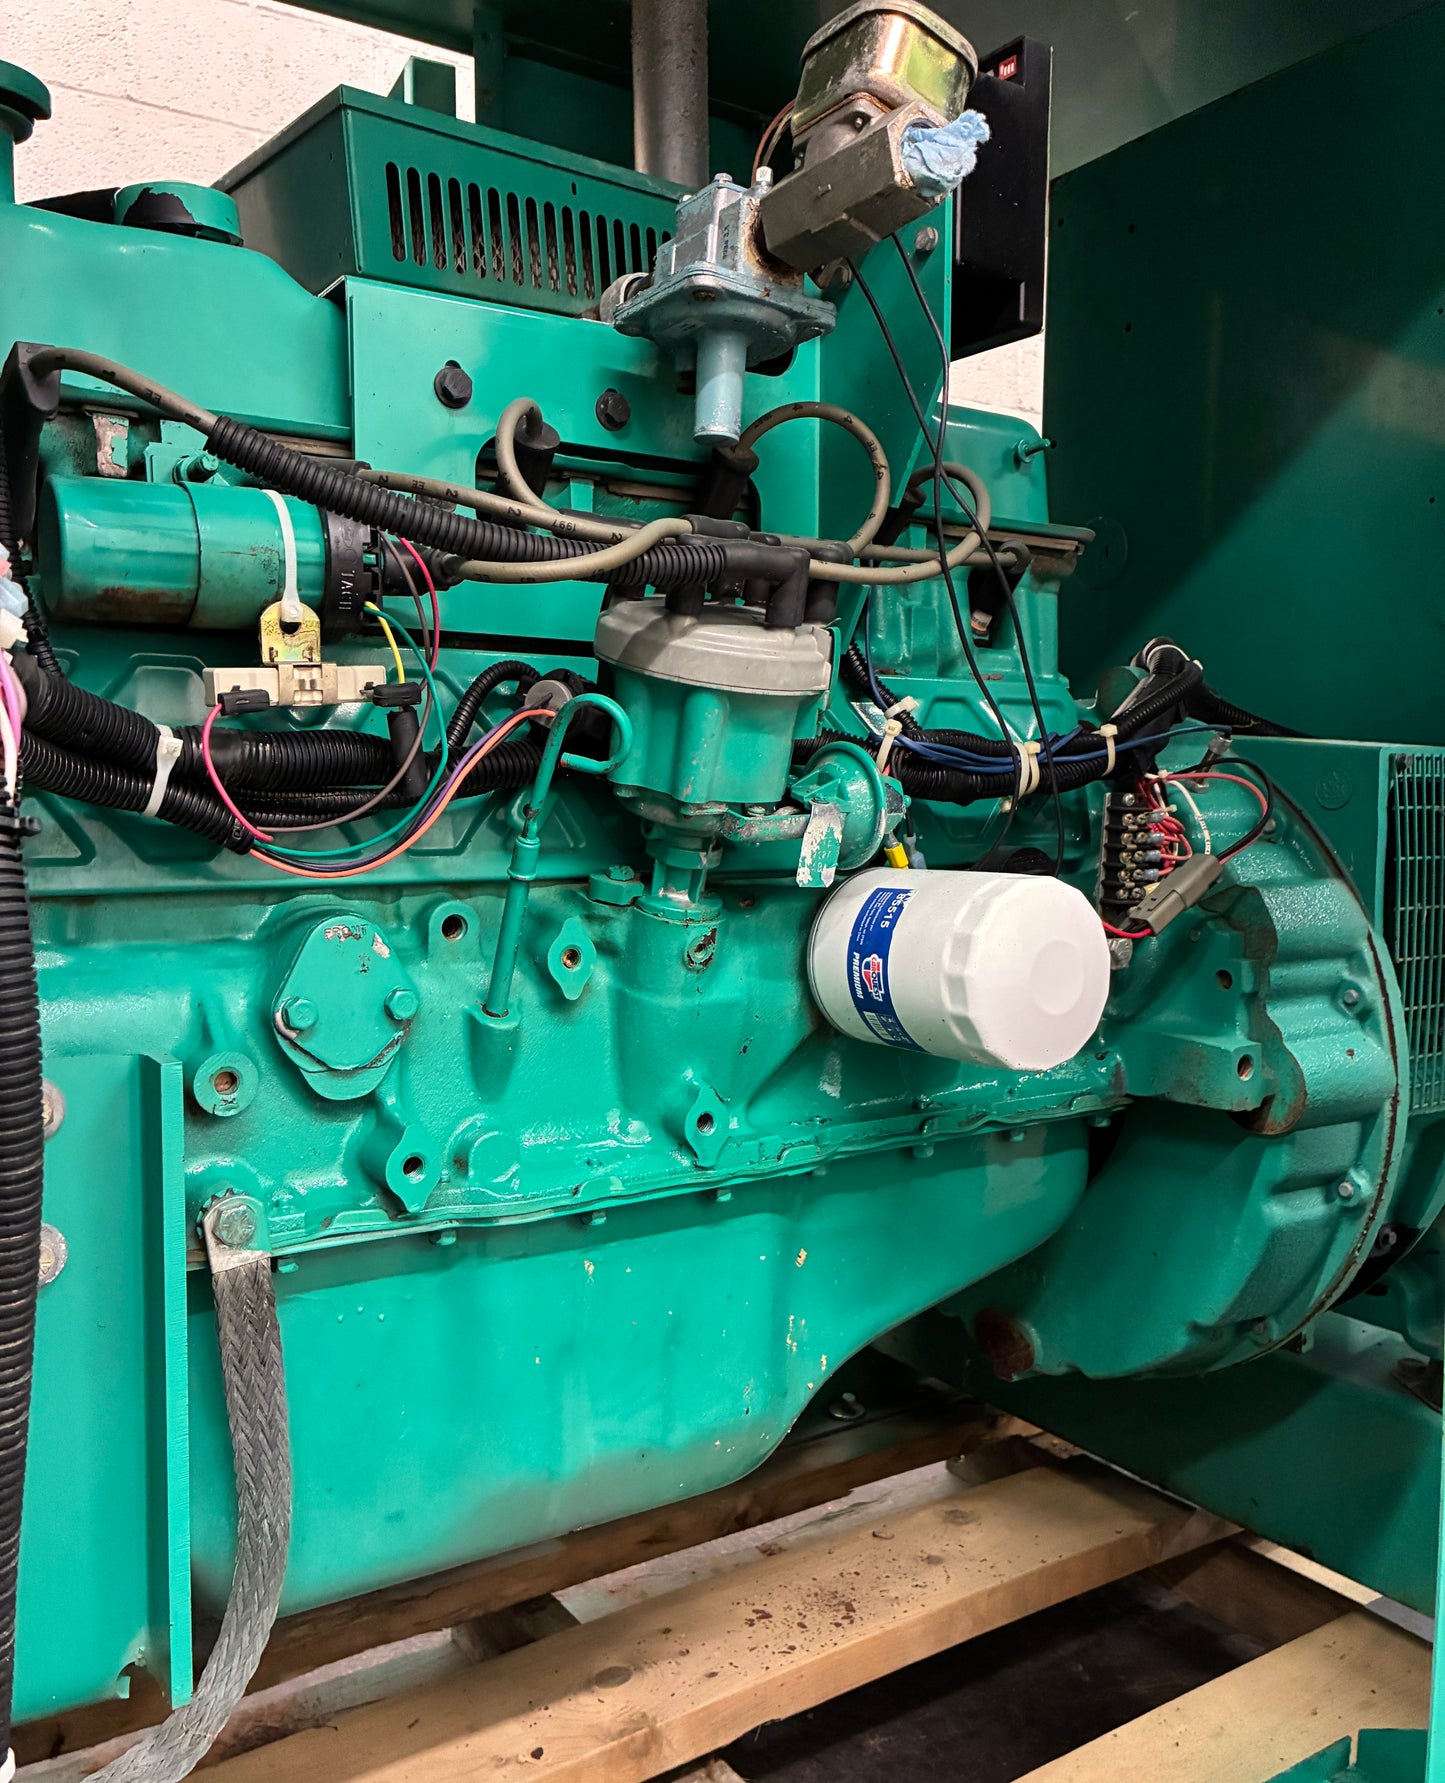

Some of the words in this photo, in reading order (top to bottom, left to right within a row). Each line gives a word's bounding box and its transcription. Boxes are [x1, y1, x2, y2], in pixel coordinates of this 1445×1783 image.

[378, 474, 389, 484] 2
[412, 479, 425, 489] EE
[446, 487, 459, 498] 2
[507, 506, 521, 517] 2
[552, 519, 576, 532] 1997
[853, 951, 864, 999] PREMIUM
